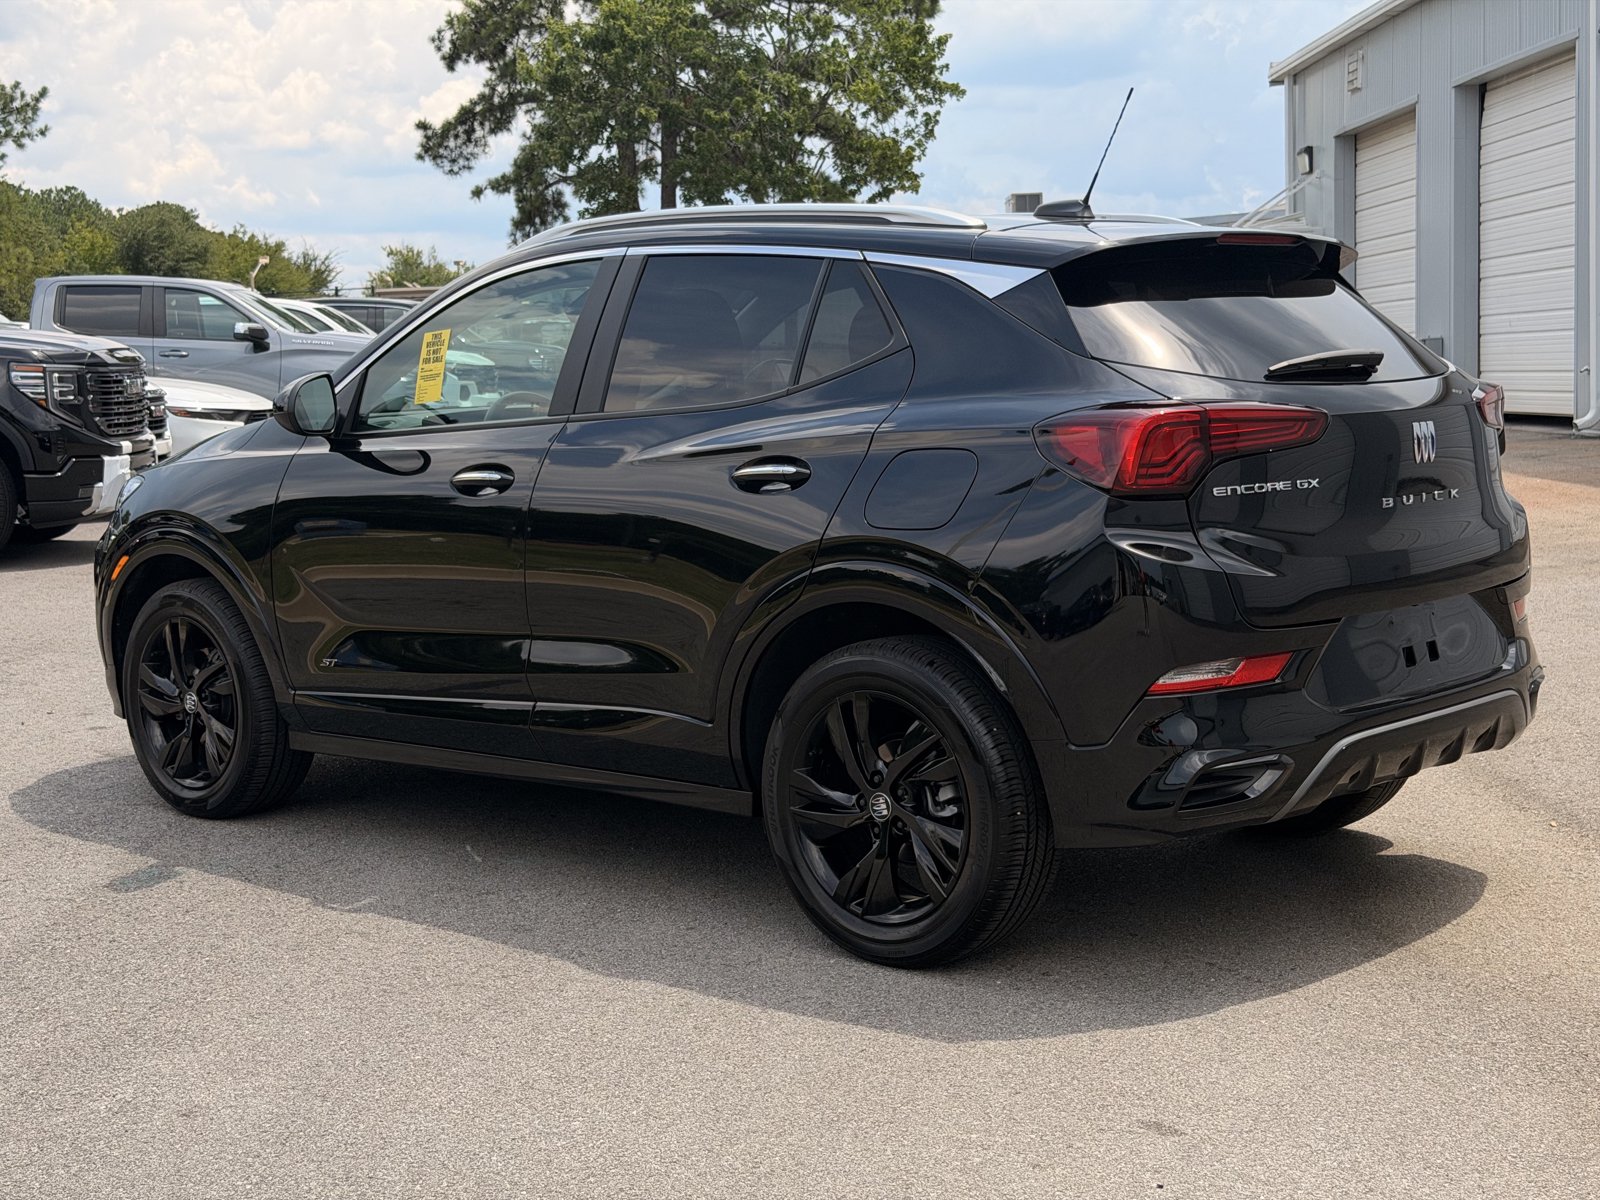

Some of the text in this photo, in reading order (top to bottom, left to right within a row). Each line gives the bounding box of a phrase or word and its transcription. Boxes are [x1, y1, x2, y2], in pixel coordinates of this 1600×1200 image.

[432, 332, 443, 340] THIS
[426, 339, 445, 348] VEHICLE
[422, 355, 443, 365] FOR SALE
[1212, 478, 1320, 497] ENCORE GX
[1382, 488, 1459, 509] BUICK
[320, 658, 338, 667] ST
